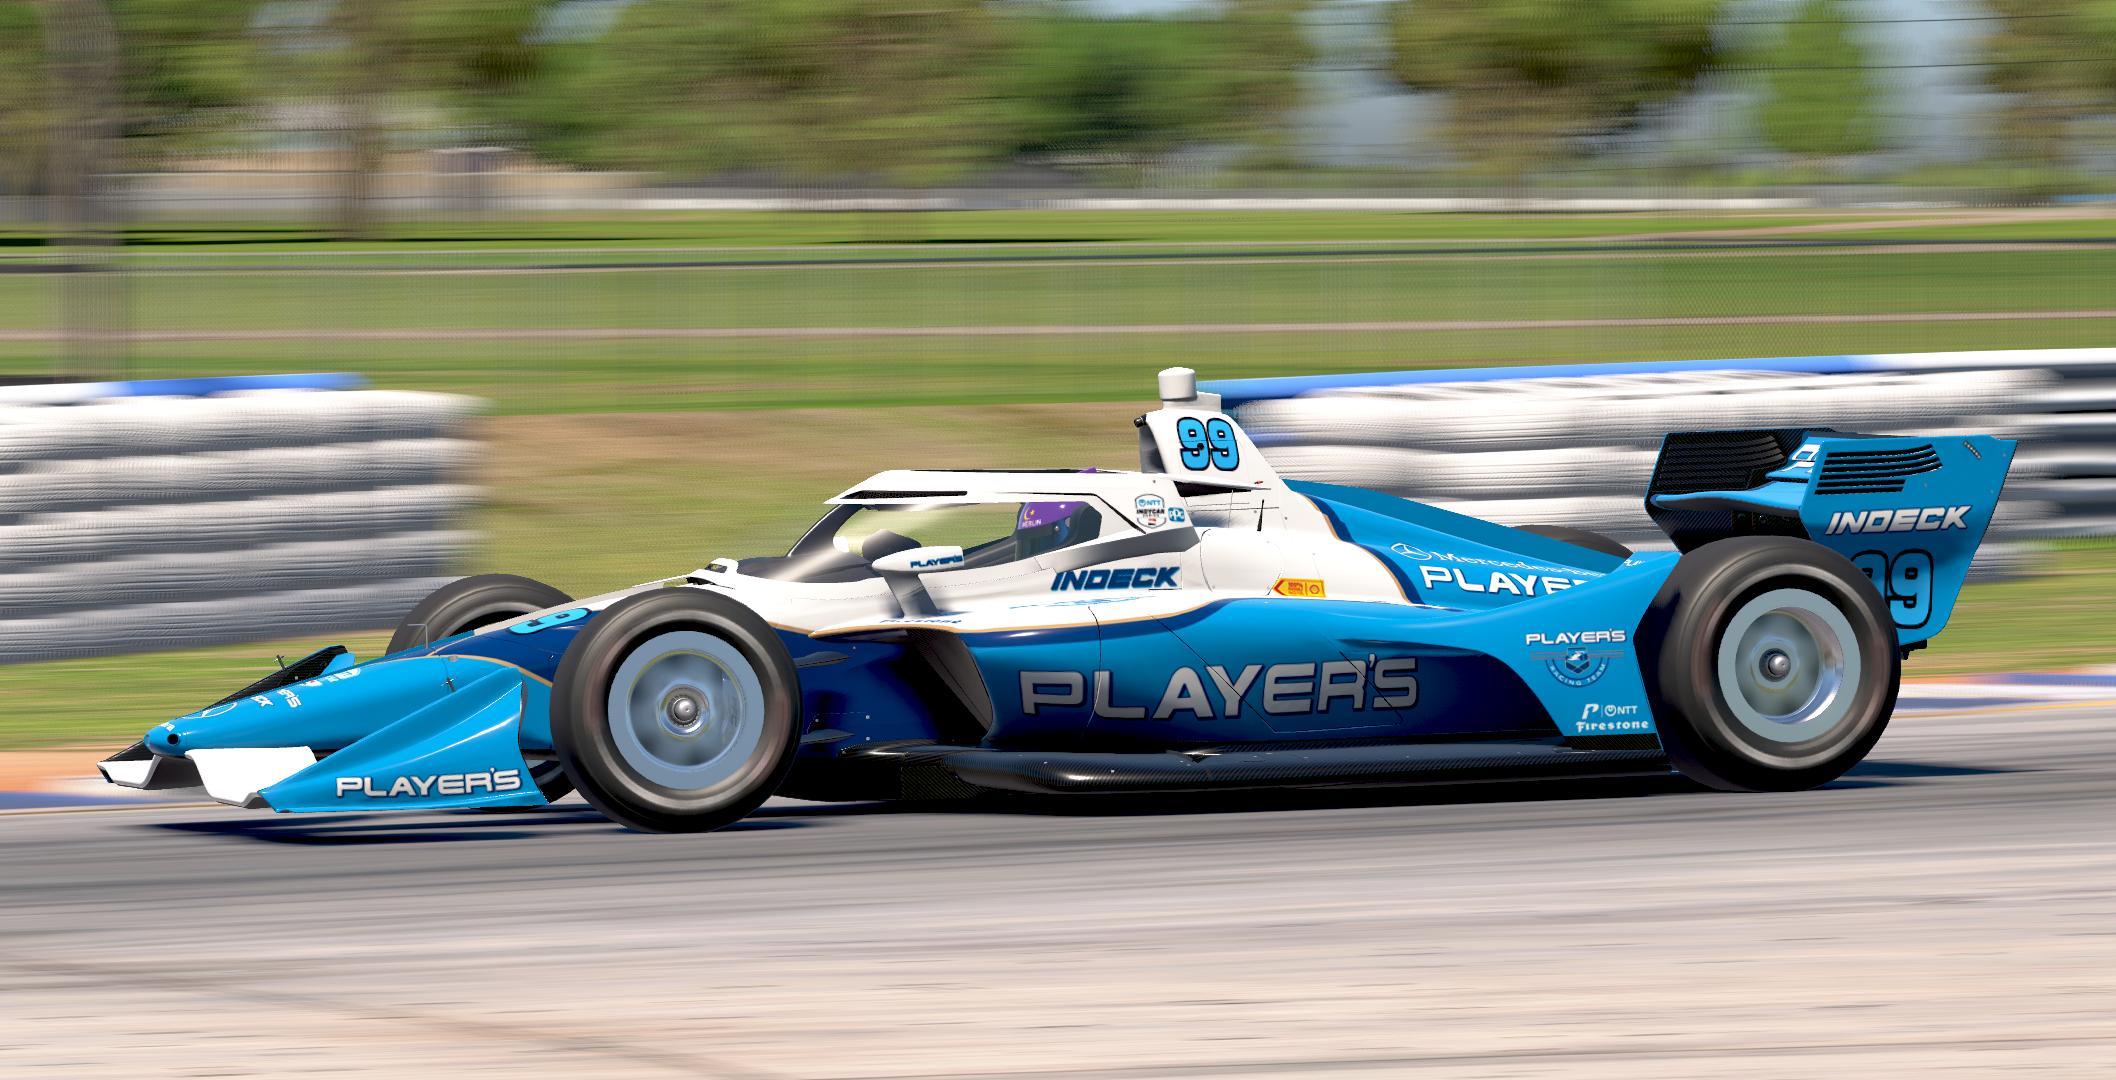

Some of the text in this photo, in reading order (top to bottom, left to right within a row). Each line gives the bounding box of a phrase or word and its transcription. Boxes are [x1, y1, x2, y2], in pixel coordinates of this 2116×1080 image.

[1177, 416, 1239, 471] 99
[1825, 505, 1972, 536] INDECK
[911, 555, 963, 568] PLAYER'S
[1050, 566, 1181, 592] INDECK
[1420, 565, 1589, 597] PLAYE
[1525, 628, 1626, 645] PLAYER'S
[1019, 654, 1418, 720] PLAYER'S
[1549, 663, 1606, 687] RACING TEAM
[1617, 705, 1638, 715] NTT
[1576, 720, 1649, 733] Firestone
[336, 767, 522, 798] PLAYER'S
